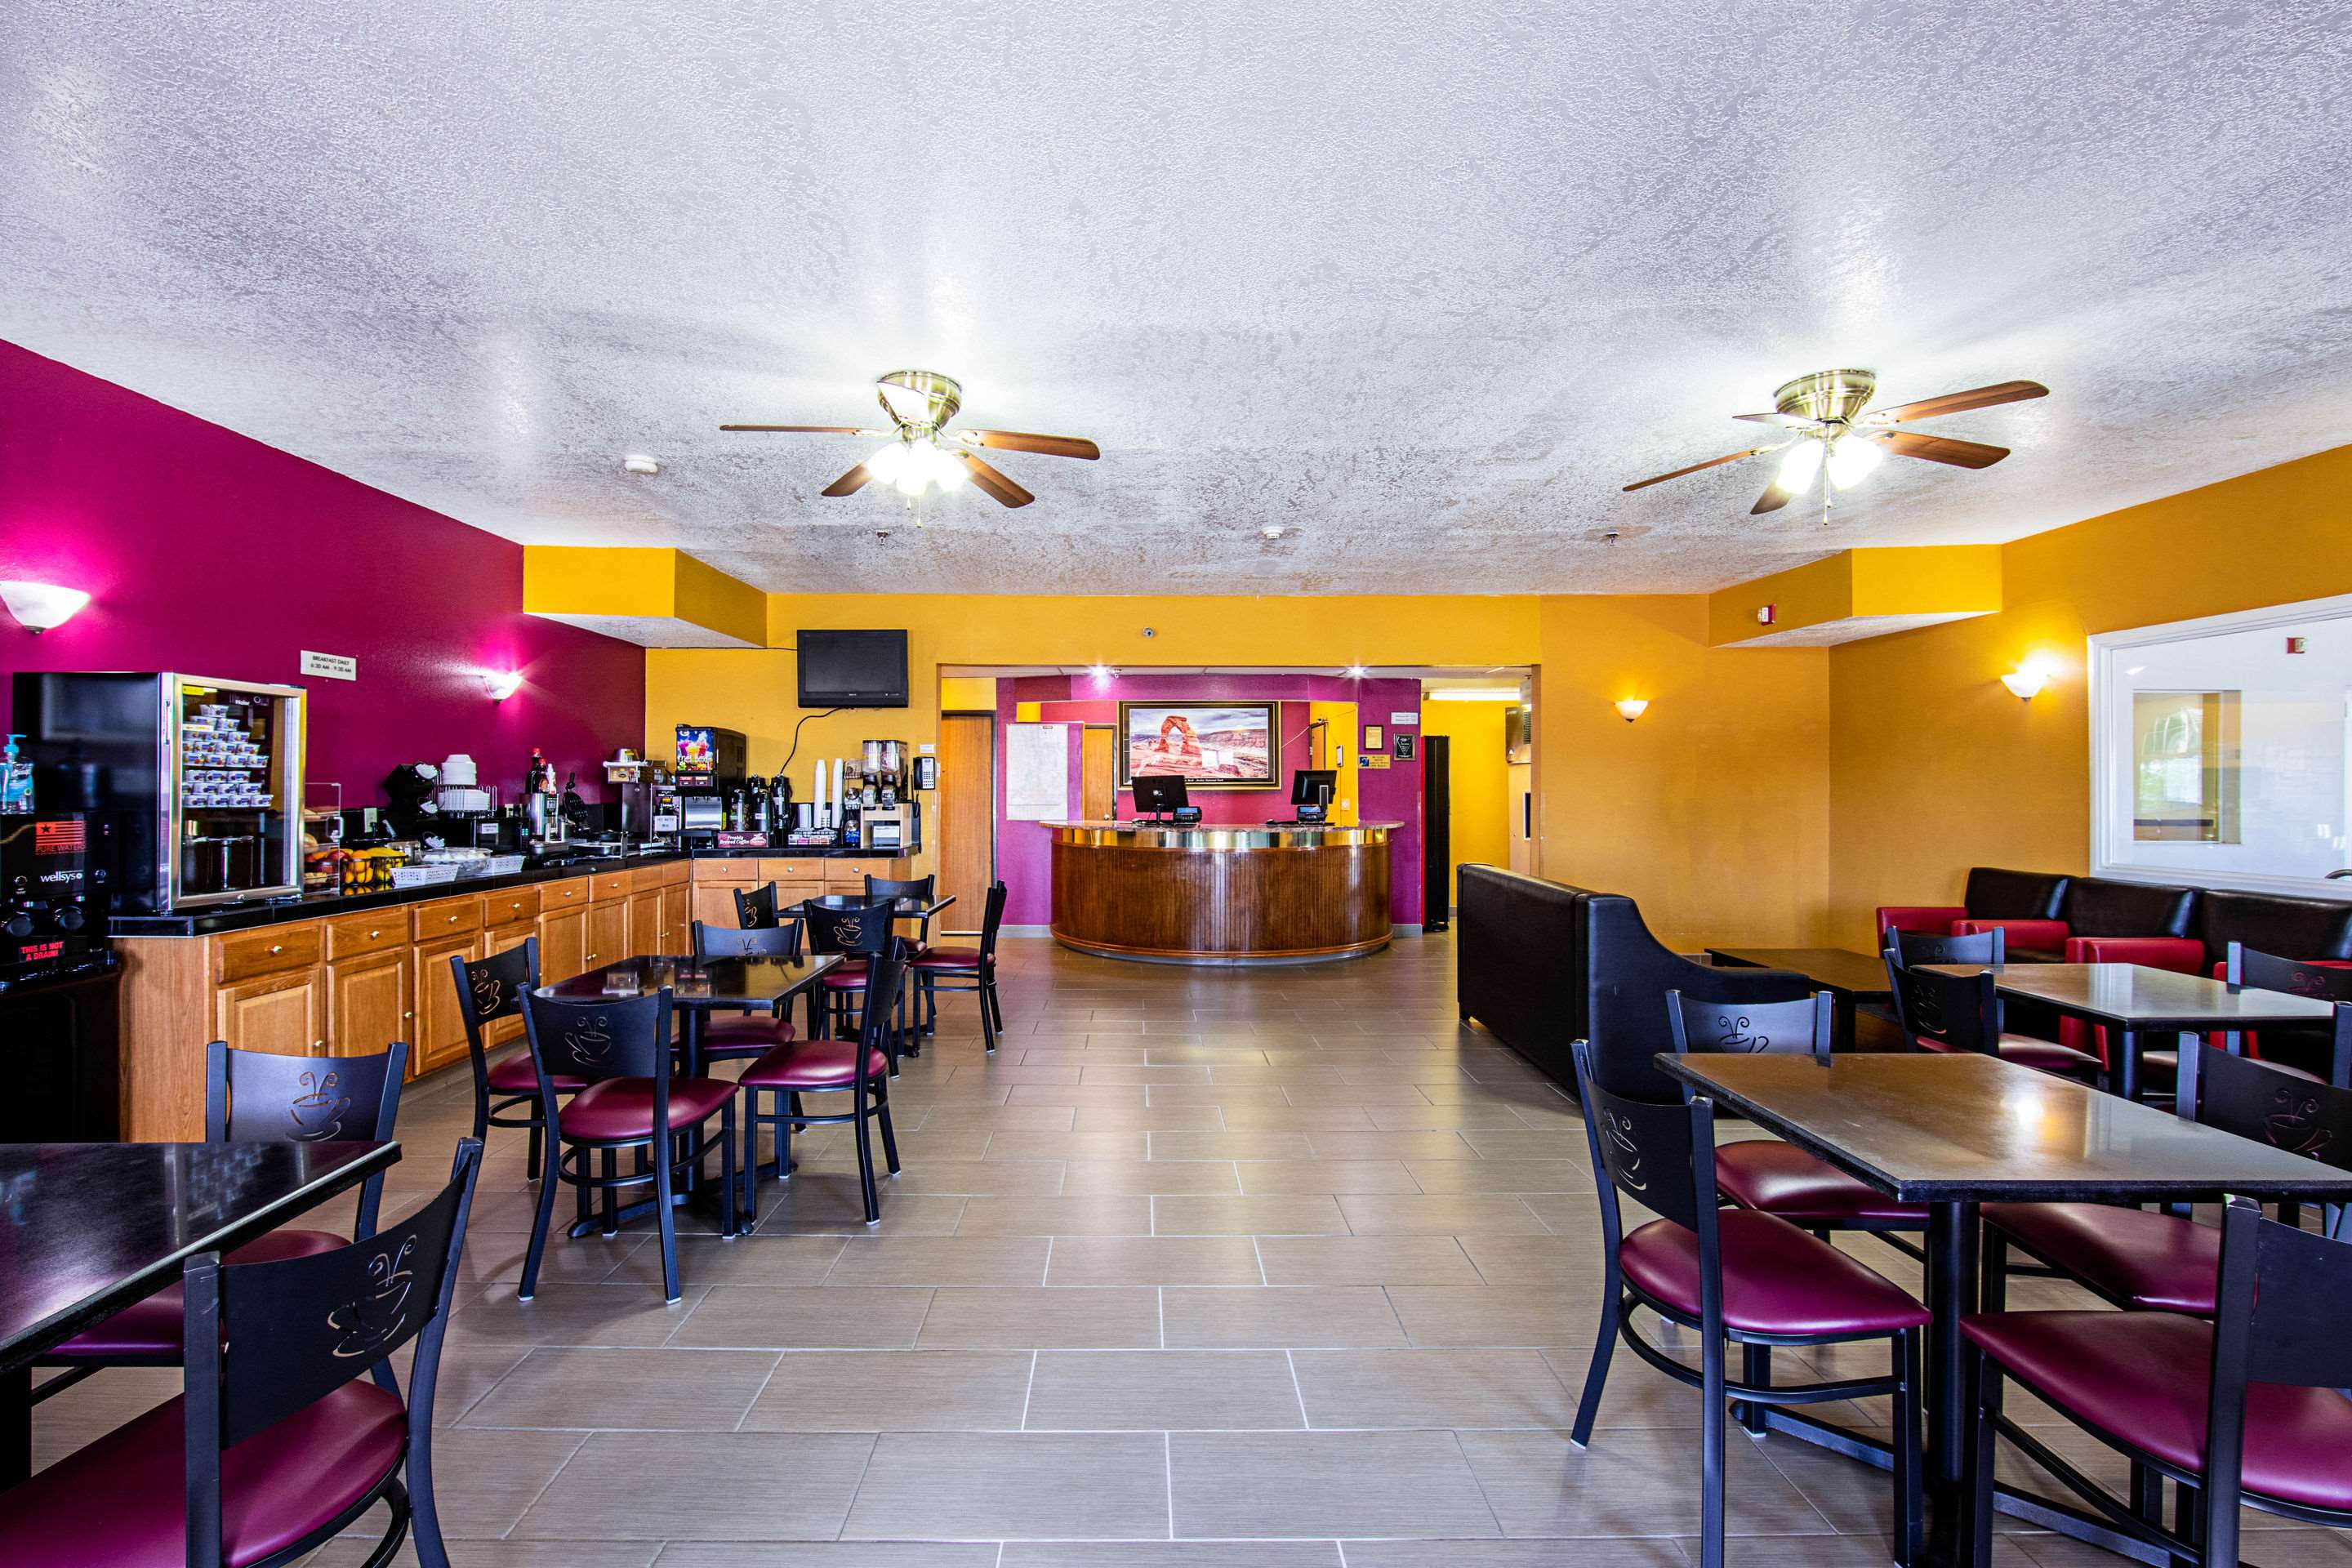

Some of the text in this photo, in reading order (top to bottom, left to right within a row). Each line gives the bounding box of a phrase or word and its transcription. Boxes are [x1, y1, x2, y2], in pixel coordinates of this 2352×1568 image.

[40, 871, 76, 883] wellsys
[21, 941, 64, 954] THIS IS NOT
